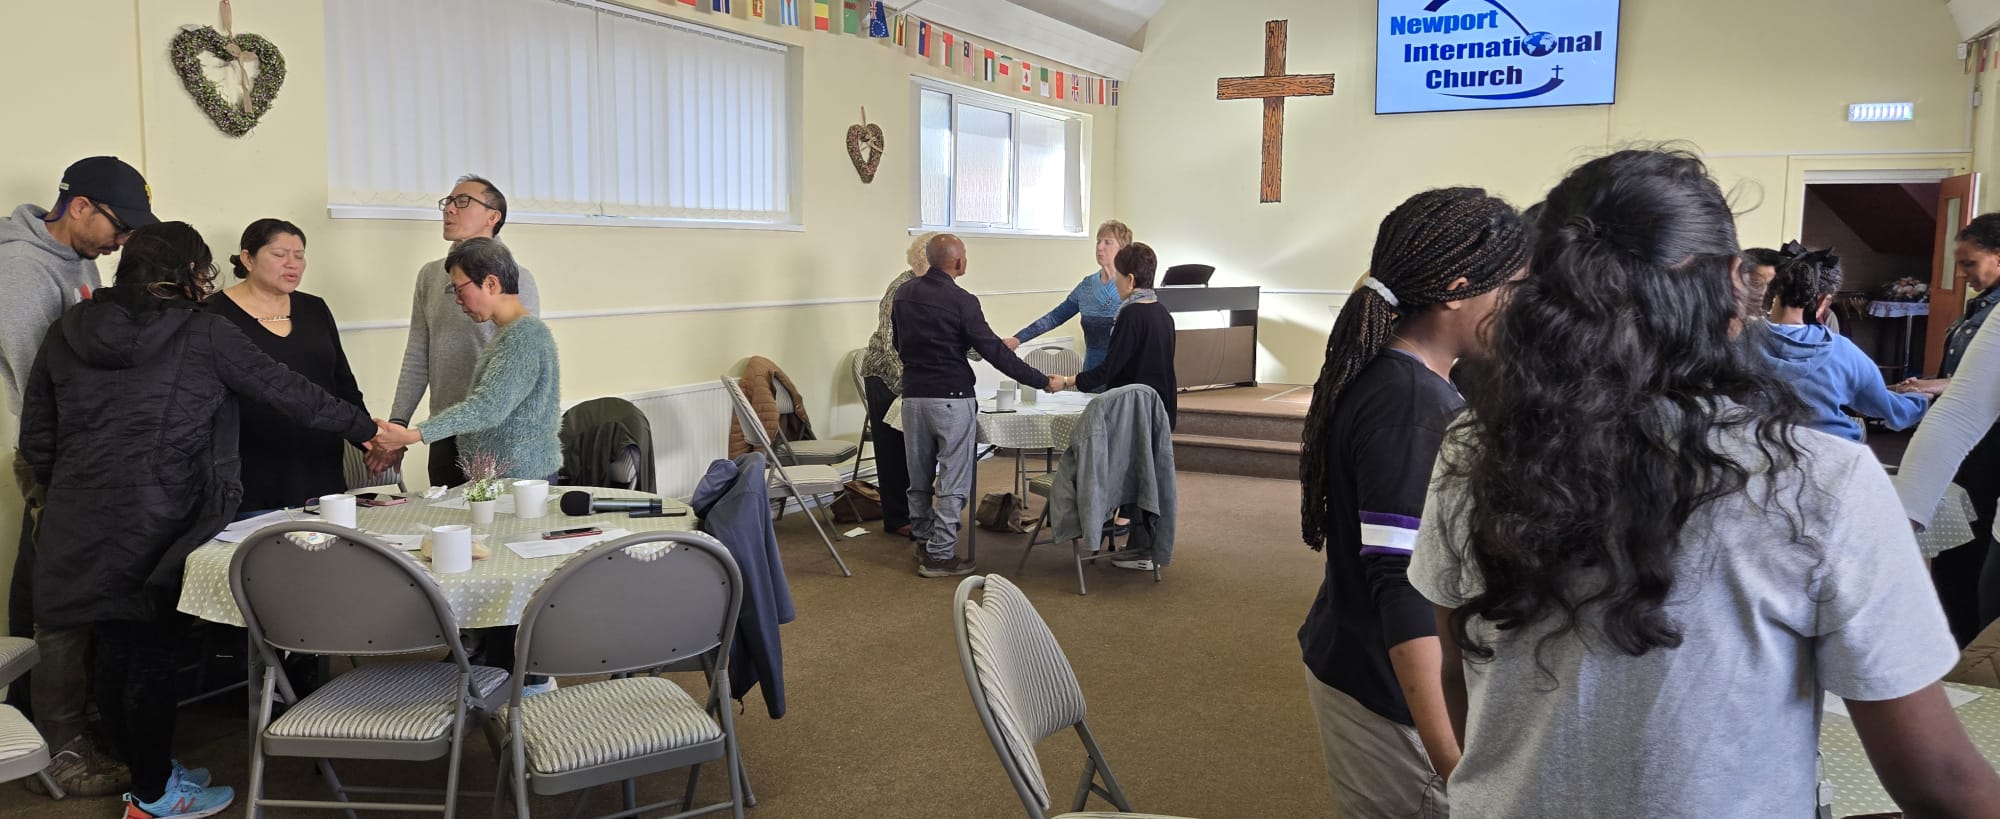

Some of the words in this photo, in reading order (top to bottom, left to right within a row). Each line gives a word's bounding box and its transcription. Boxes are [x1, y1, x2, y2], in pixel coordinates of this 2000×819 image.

[1390, 10, 1499, 36] Newport
[1404, 31, 1602, 63] International
[1425, 65, 1523, 89] Church
